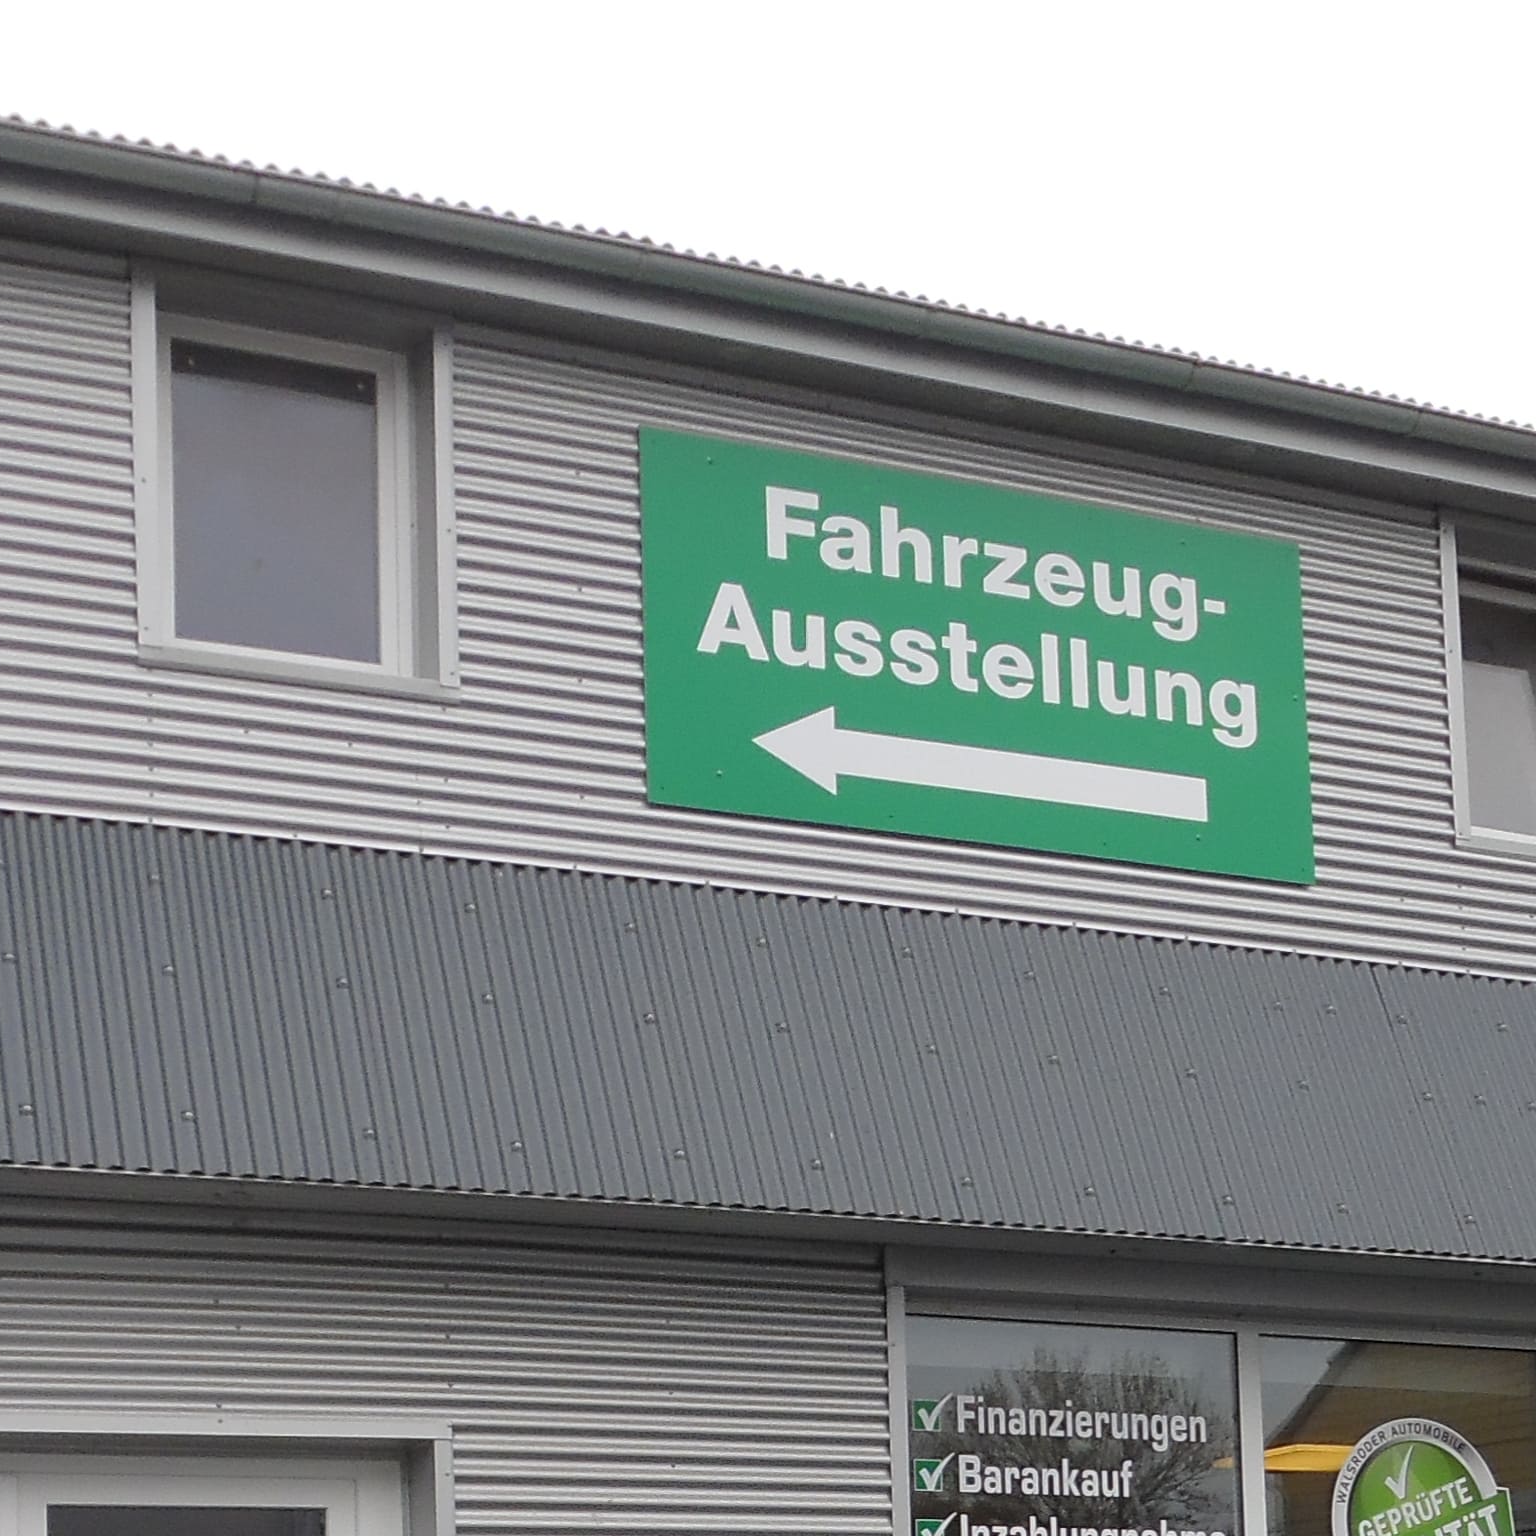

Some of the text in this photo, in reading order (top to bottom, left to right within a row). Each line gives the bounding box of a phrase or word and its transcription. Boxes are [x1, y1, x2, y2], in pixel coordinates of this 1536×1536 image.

[765, 485, 1227, 642] Fahrzeug-
[696, 582, 1259, 749] Ausstellung
[956, 1395, 1207, 1452] Finanzierungen
[1336, 1422, 1466, 1505] WALSRODER AUTOMOBILE
[957, 1454, 1133, 1498] Barankauf
